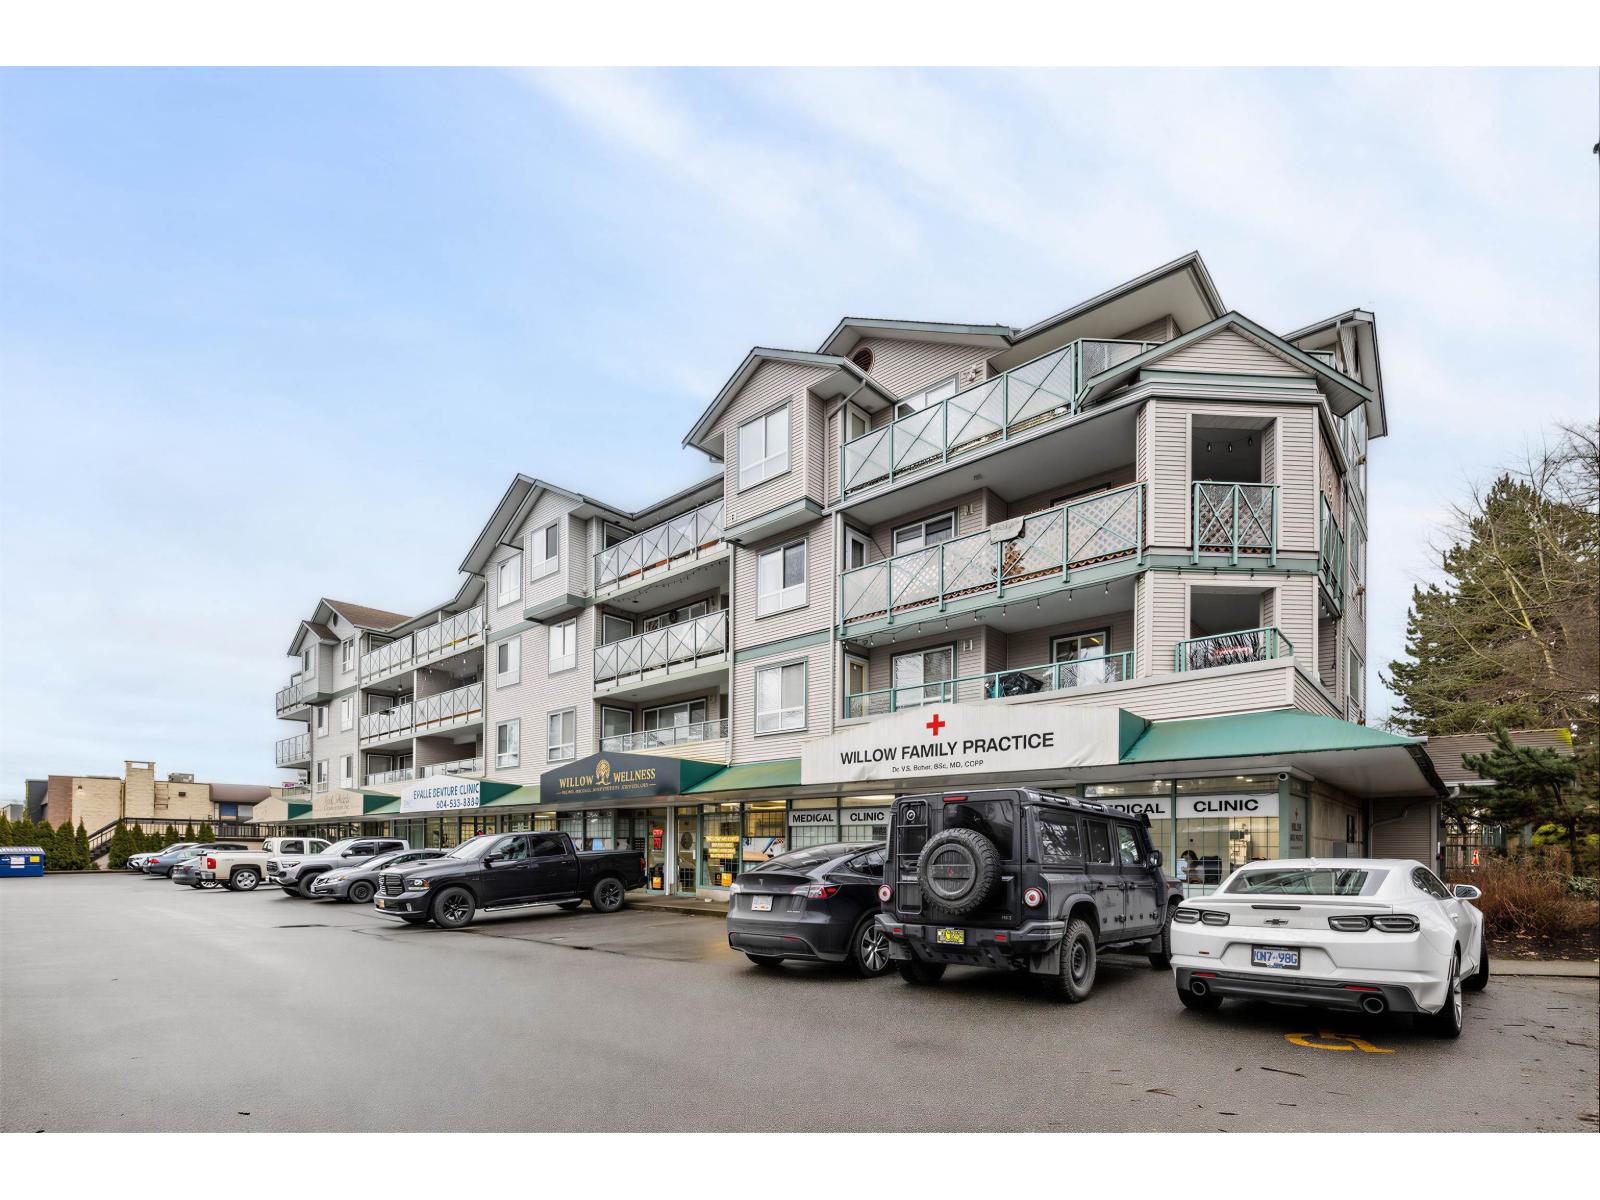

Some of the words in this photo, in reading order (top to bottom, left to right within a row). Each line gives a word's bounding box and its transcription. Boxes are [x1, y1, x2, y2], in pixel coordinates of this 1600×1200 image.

[841, 746, 897, 765] WILLOW
[901, 741, 957, 760] FAMILY
[962, 732, 1055, 755] PRACTICE
[560, 775, 594, 789] WILLOW
[613, 768, 656, 783] WELLNESS
[433, 785, 458, 798] DENTURE
[459, 783, 480, 795] CLINIC
[1105, 802, 1166, 814] DICAL
[1193, 798, 1259, 813] CLINIC
[792, 813, 834, 823] MEDICAL
[850, 811, 885, 822] CLINIC
